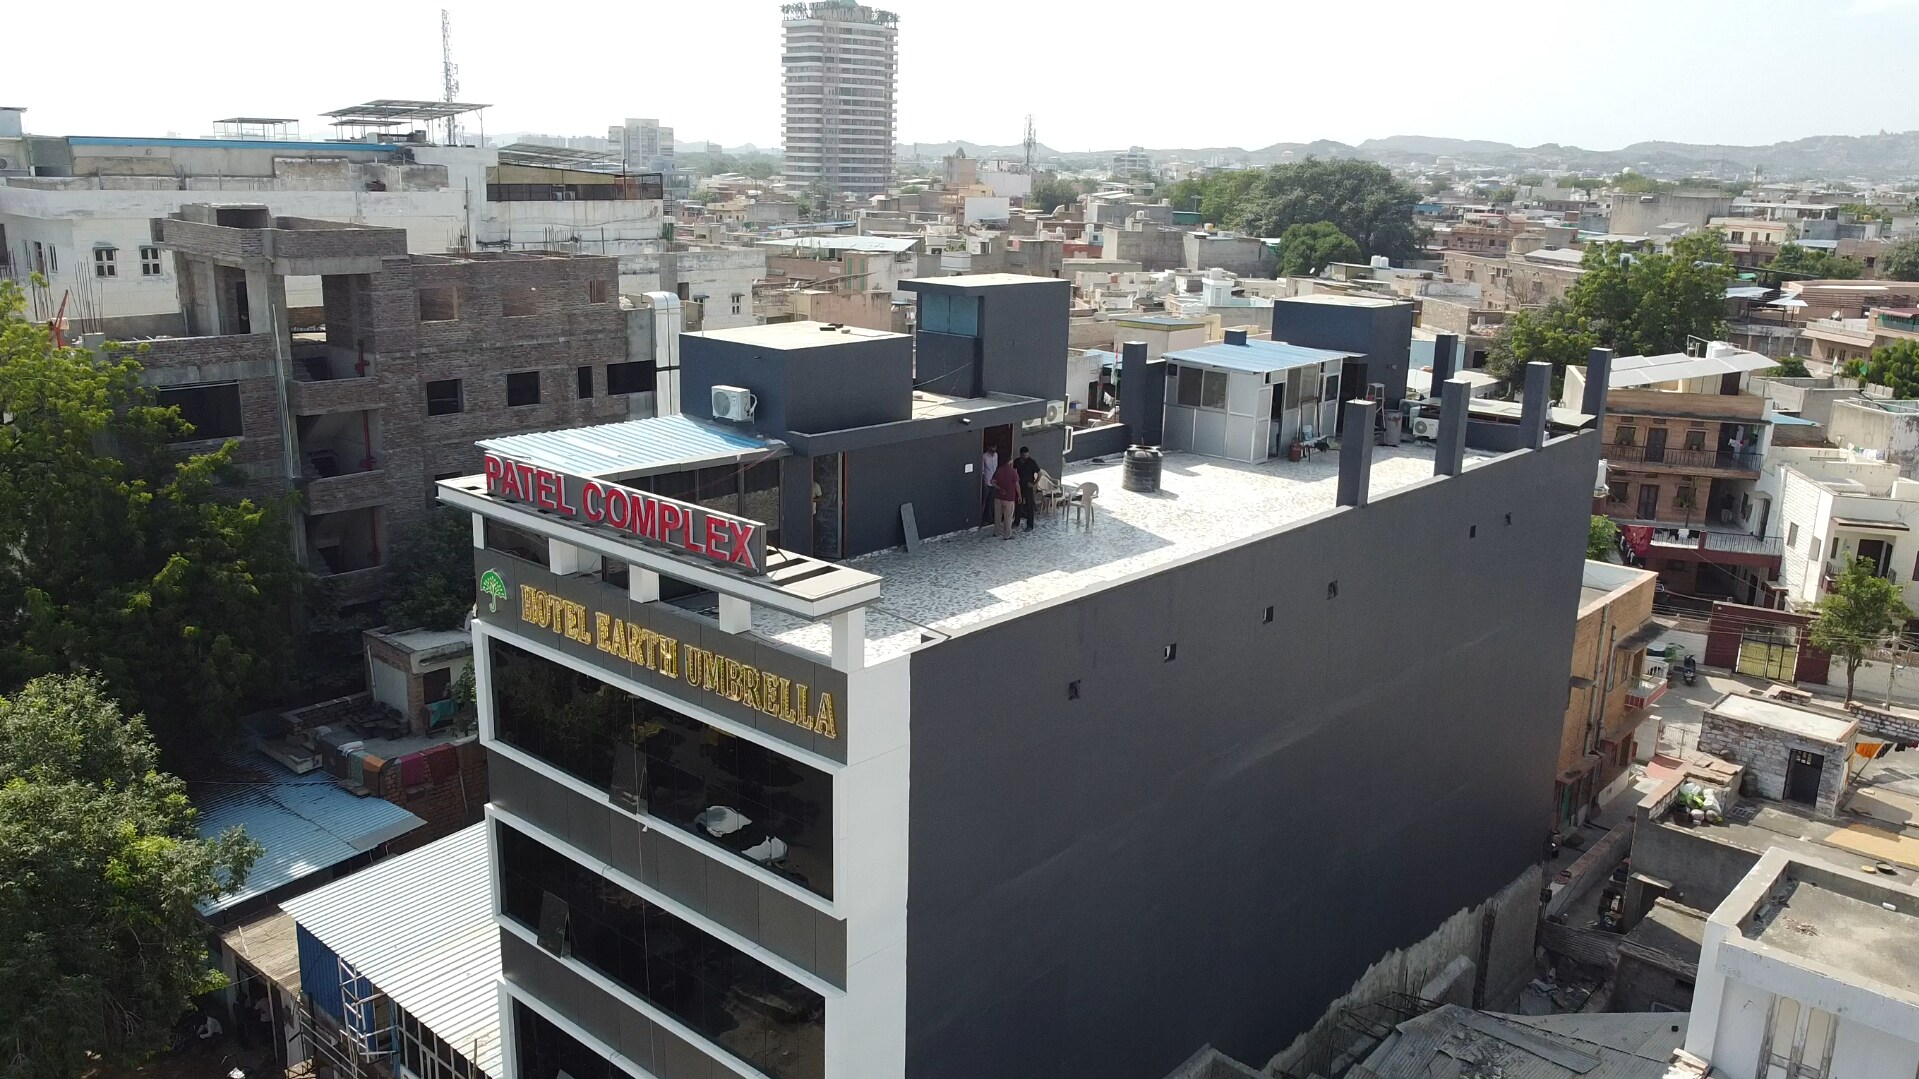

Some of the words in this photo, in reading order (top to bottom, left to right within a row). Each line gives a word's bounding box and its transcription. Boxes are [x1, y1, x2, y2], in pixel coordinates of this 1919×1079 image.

[485, 454, 576, 515] PATEL
[583, 481, 760, 573] COMPLEX
[520, 584, 592, 645] HOTEL
[595, 611, 679, 679] EARTH
[684, 644, 837, 739] UMBRELLA
